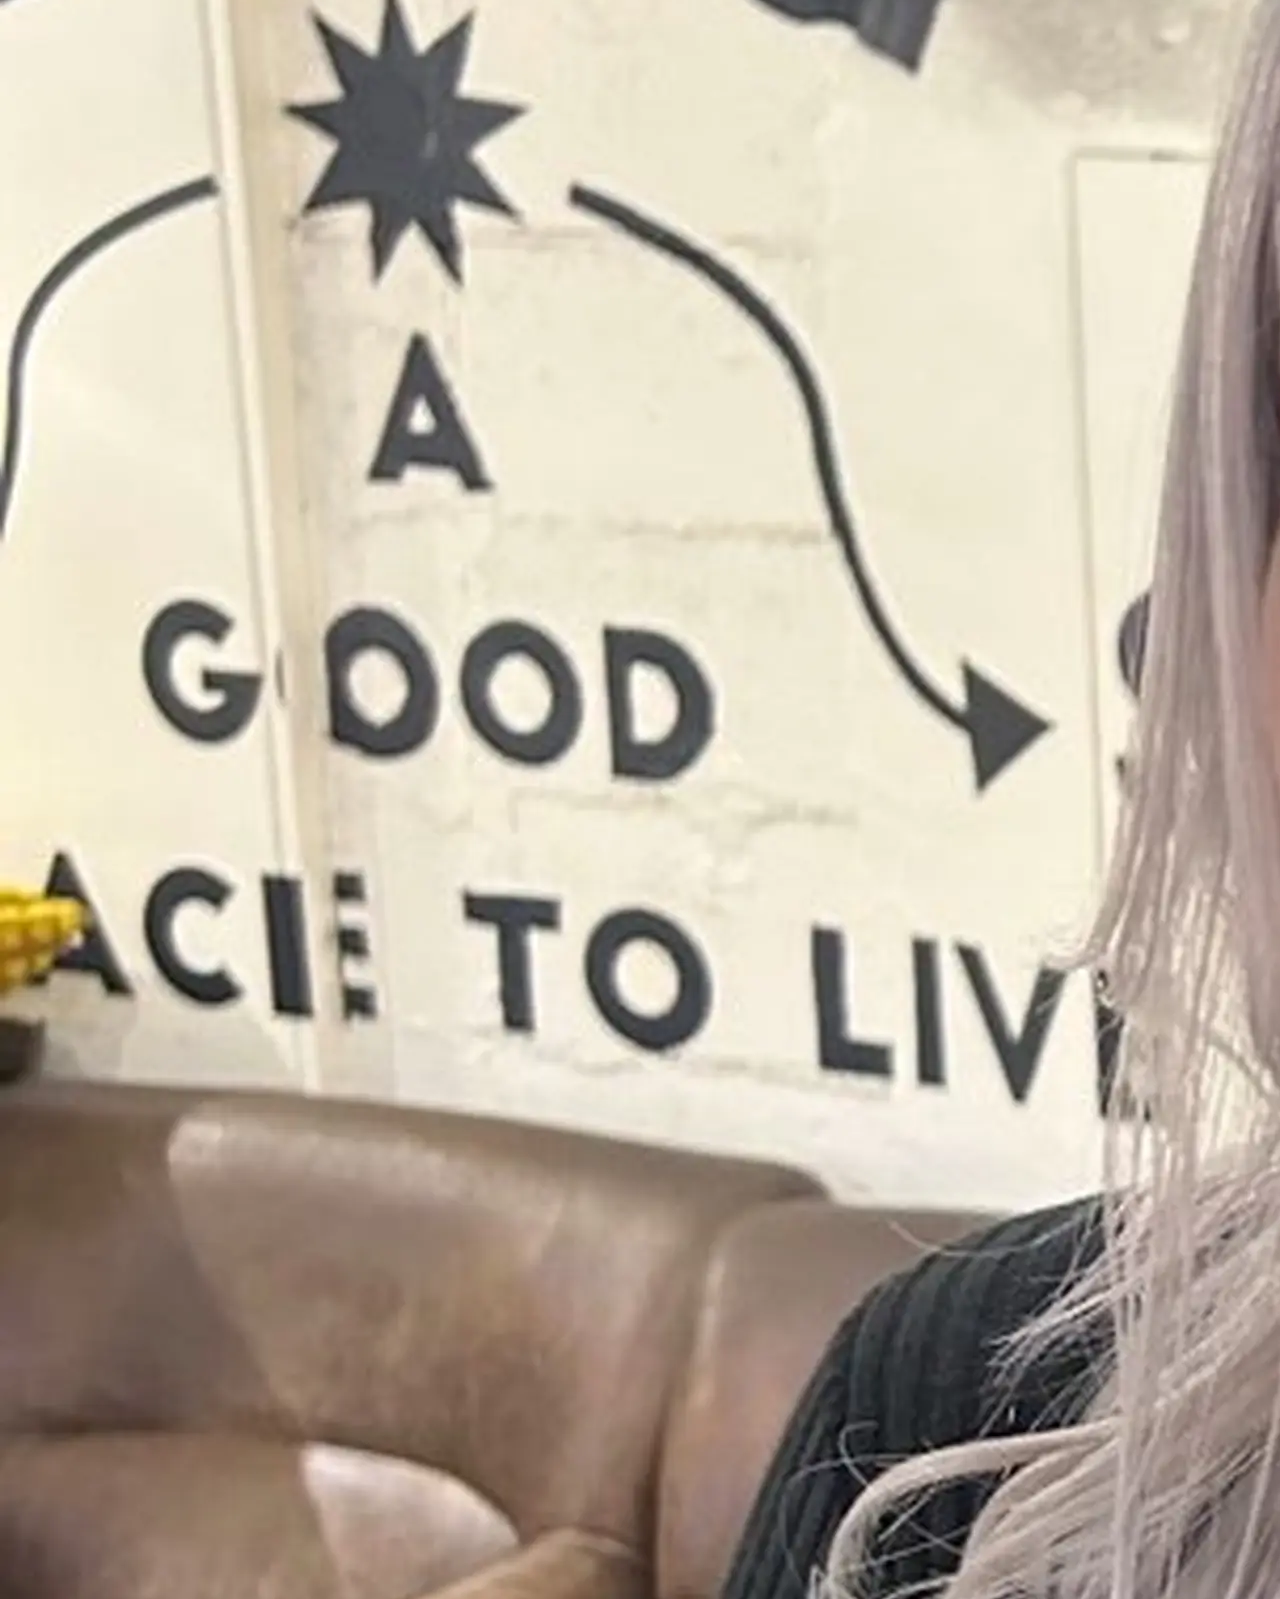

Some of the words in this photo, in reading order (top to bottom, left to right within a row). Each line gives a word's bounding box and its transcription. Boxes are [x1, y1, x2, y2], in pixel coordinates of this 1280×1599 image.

[368, 332, 491, 491] A
[142, 600, 716, 781] GOOD
[463, 888, 711, 1052] TO
